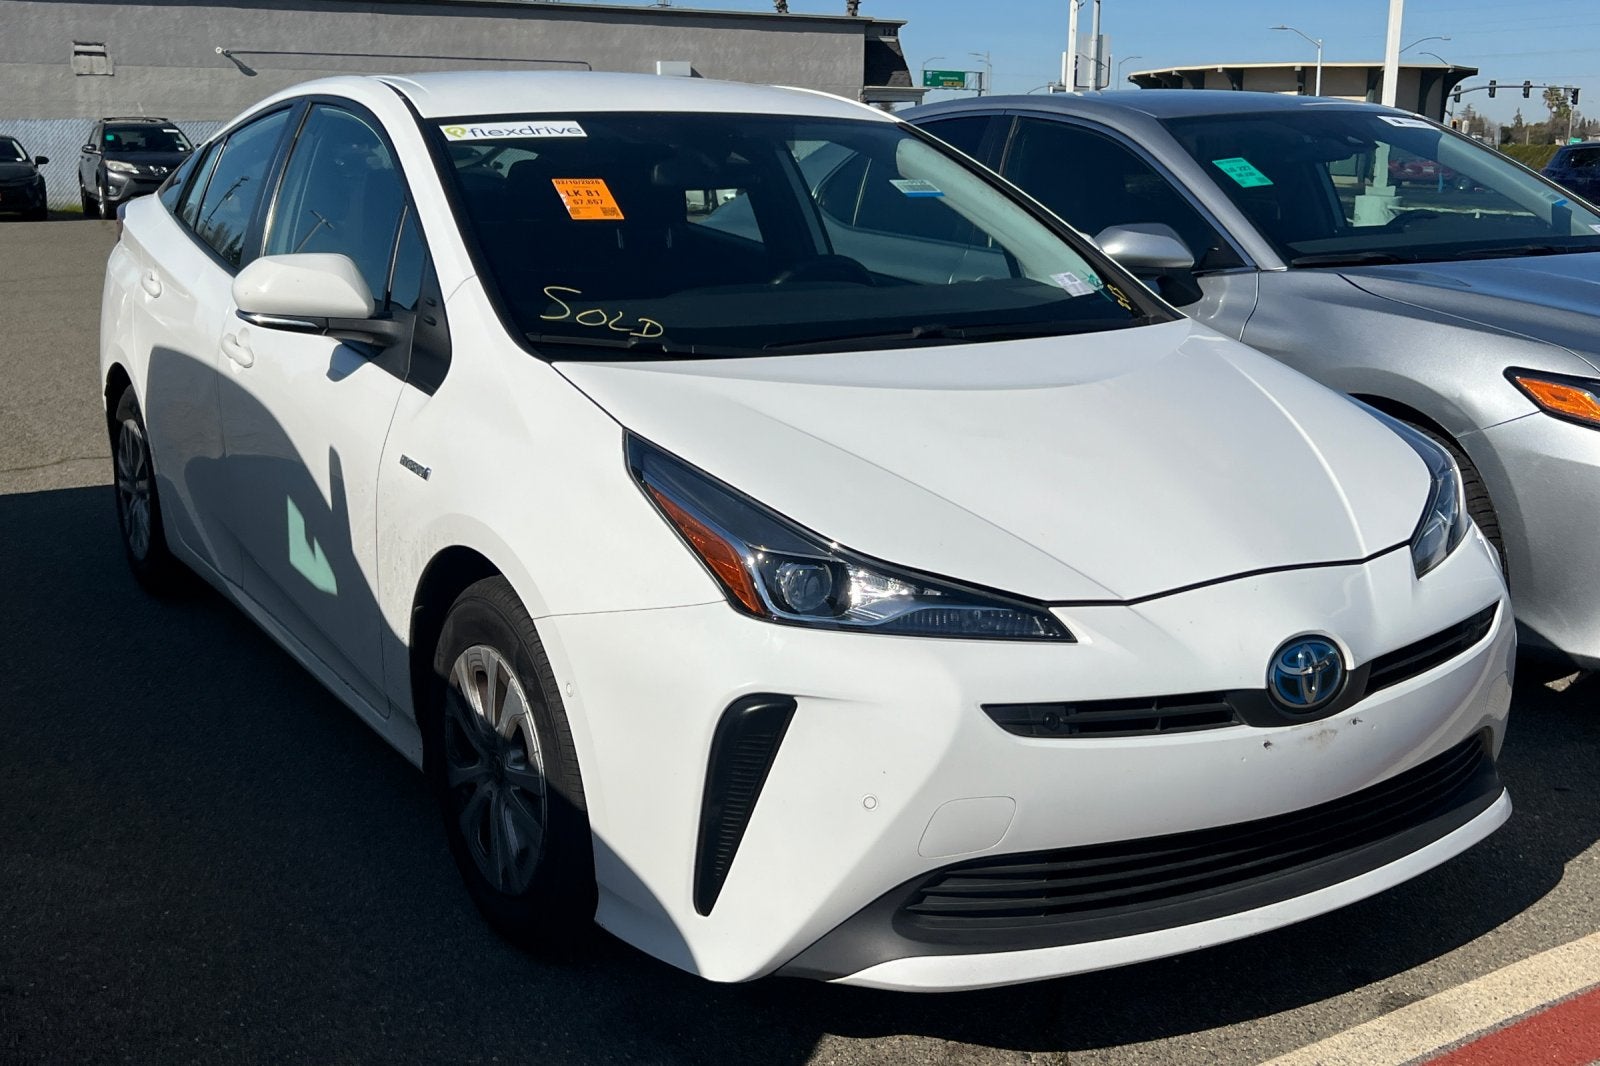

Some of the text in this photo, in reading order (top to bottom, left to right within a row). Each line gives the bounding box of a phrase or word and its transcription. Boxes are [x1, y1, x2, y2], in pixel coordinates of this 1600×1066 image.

[468, 125, 582, 138] flexdrive
[566, 189, 600, 197] LK 81
[540, 286, 663, 337] SOLD
